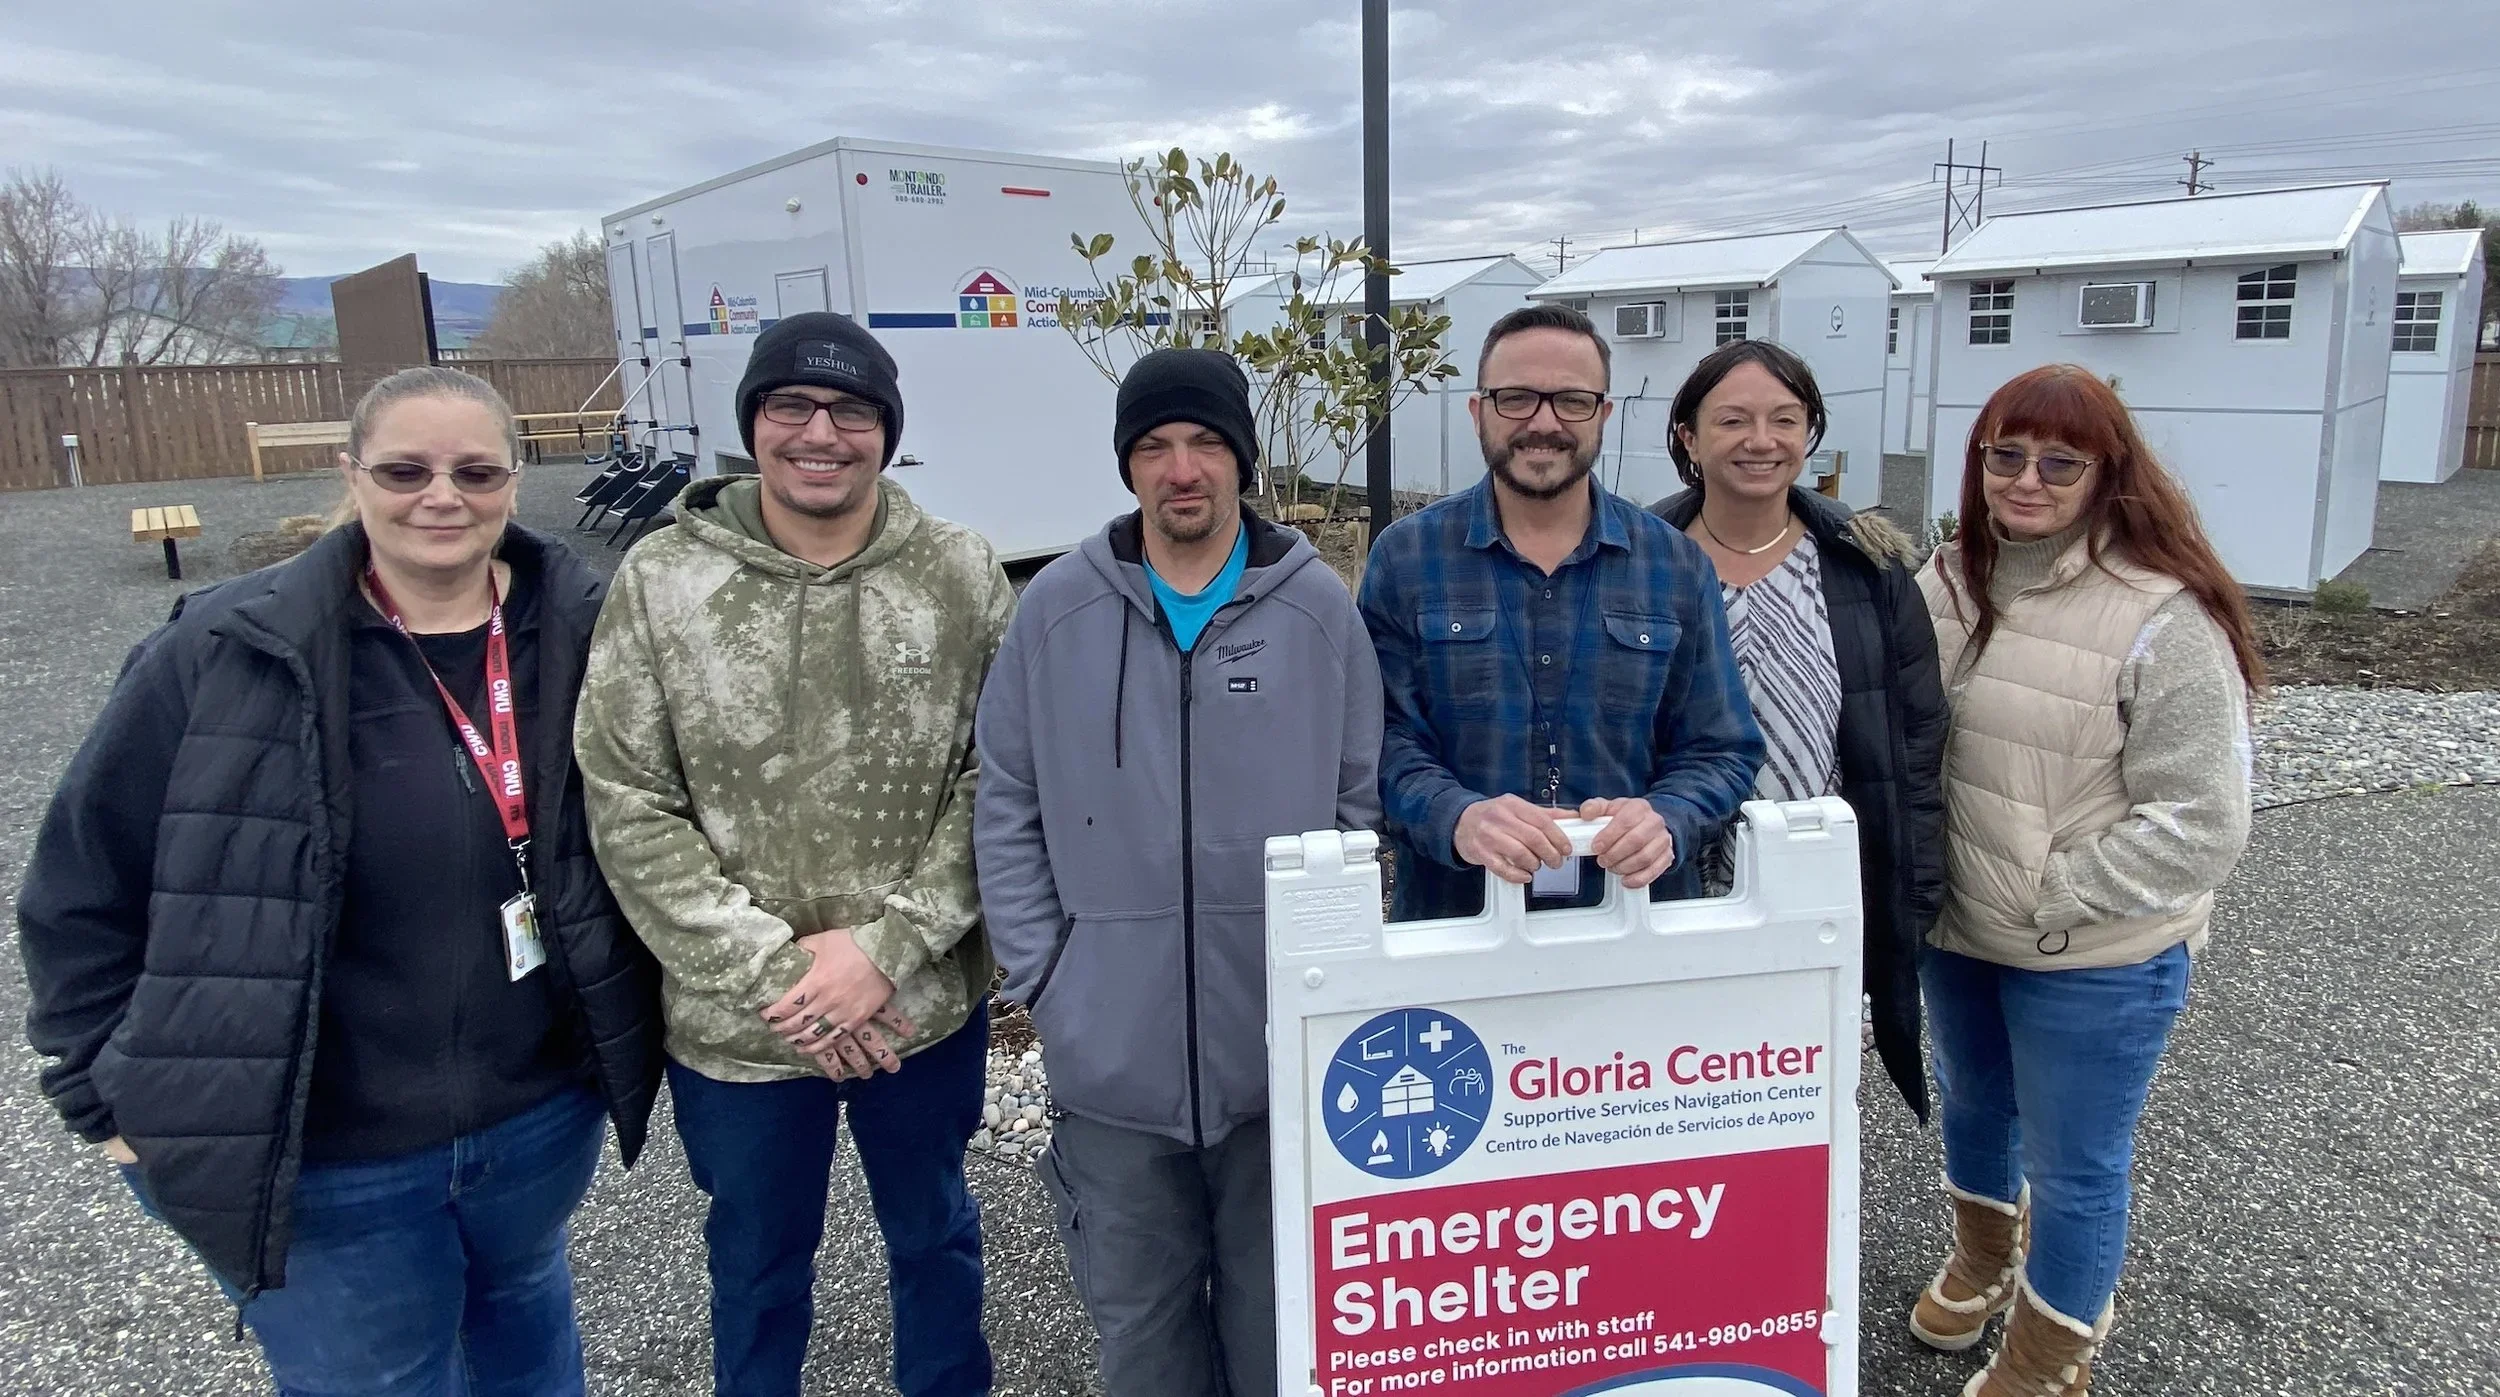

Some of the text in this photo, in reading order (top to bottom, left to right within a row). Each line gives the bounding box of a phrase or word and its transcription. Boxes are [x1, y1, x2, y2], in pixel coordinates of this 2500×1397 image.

[1024, 286, 1105, 298] Mid-Columbia
[807, 356, 858, 376] YESHUA
[1215, 639, 1266, 661] Milwaukee
[892, 667, 932, 675] FREEDOM
[492, 679, 511, 714] CWU
[460, 723, 488, 757] CWU
[502, 759, 521, 797] CWU
[1501, 1043, 1526, 1055] The
[1509, 1041, 1823, 1101] Gloria Center
[1503, 1084, 1822, 1128] Supportive Services Navigation Center
[1486, 1110, 1815, 1154] Centro de Navegación de Servicios de Apoyo
[1330, 1182, 1727, 1272] Emergency
[1332, 1264, 1590, 1336] Shelter
[1330, 1310, 1655, 1372] Please check in with staff
[1331, 1309, 1818, 1397] For more information call 541-980-0855
